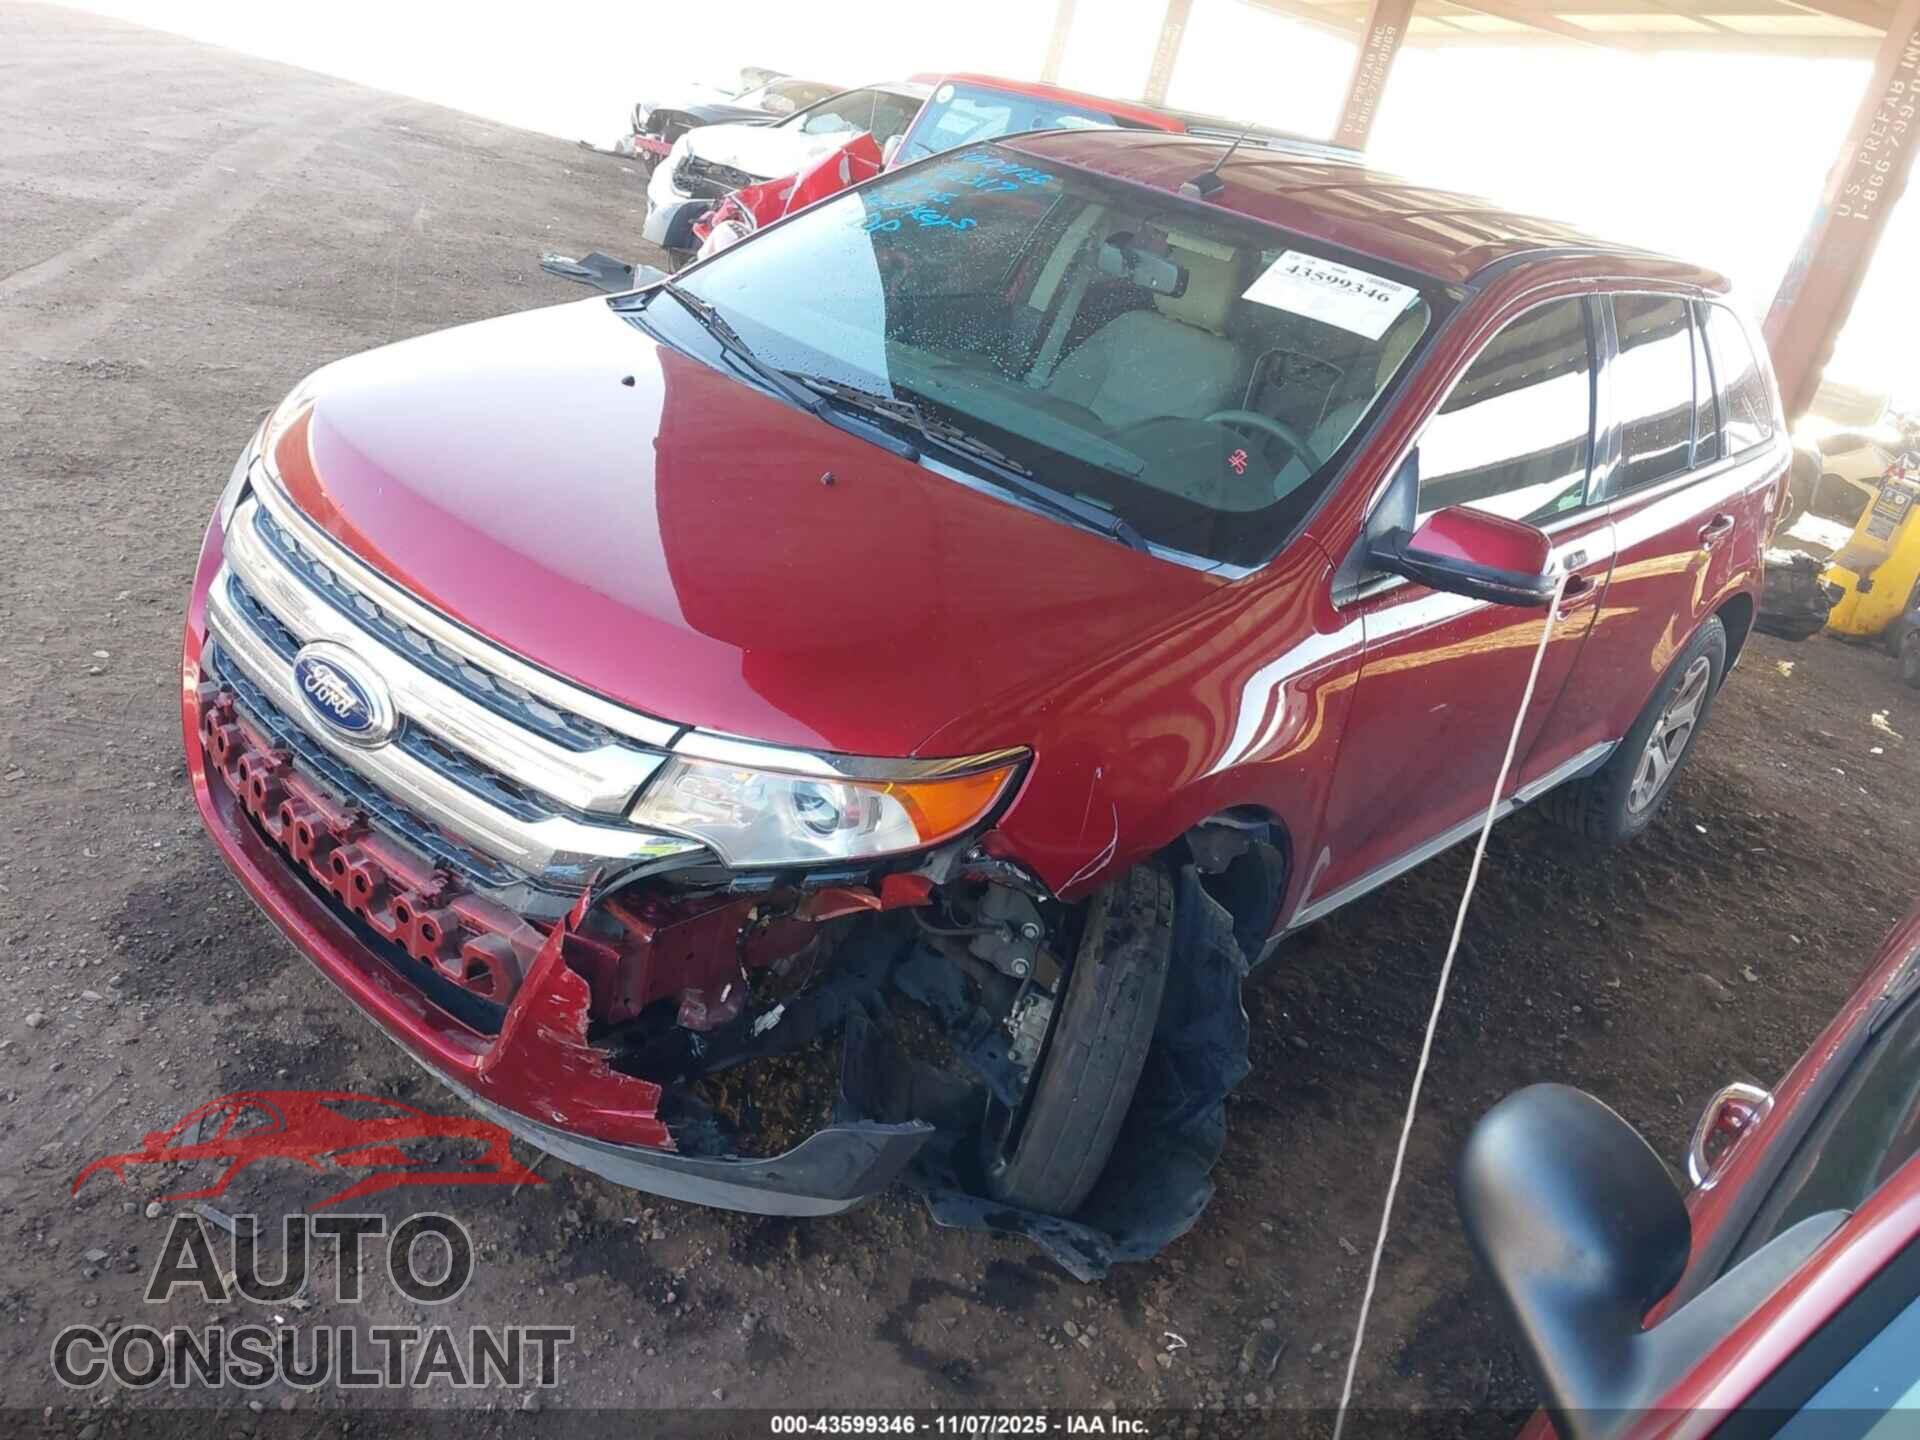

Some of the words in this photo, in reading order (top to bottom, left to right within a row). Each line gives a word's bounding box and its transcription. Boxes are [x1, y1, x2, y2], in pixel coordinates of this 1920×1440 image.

[1837, 178, 1864, 217] U.S.
[1858, 80, 1905, 165] PREFAB
[1285, 263, 1390, 303] 43599346
[304, 663, 354, 718] Ford
